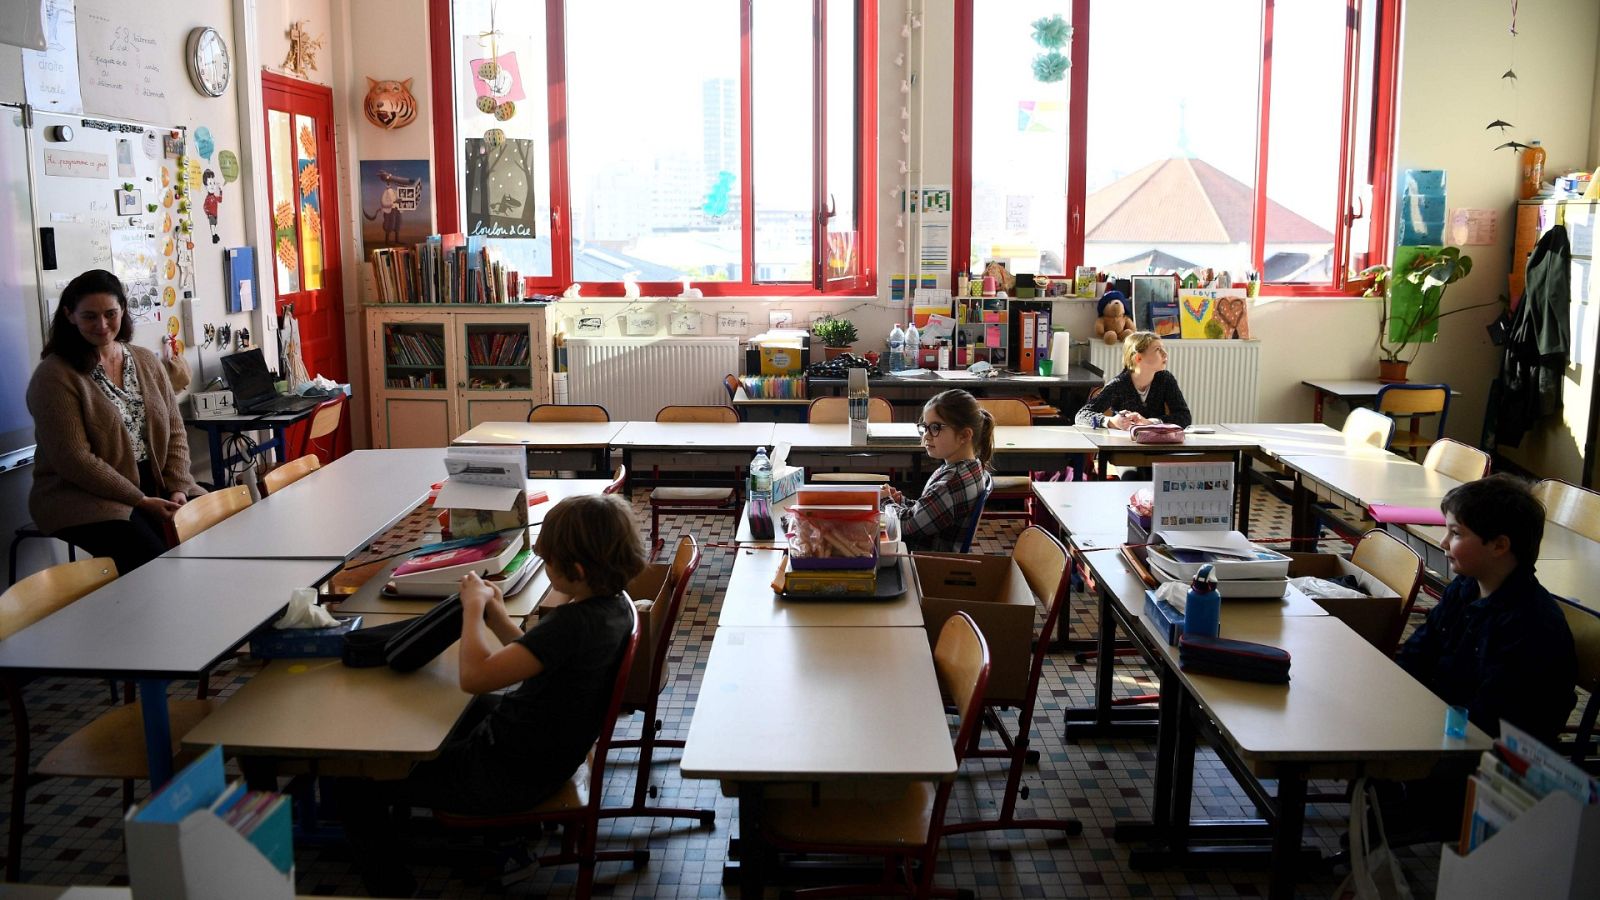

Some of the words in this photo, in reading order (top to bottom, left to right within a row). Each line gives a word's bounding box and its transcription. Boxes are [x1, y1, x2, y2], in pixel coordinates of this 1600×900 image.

[38, 59, 64, 72] droite
[472, 221, 508, 236] loulou
[517, 224, 531, 236] Cie
[1193, 290, 1216, 298] LOVE
[219, 395, 229, 407] 4
